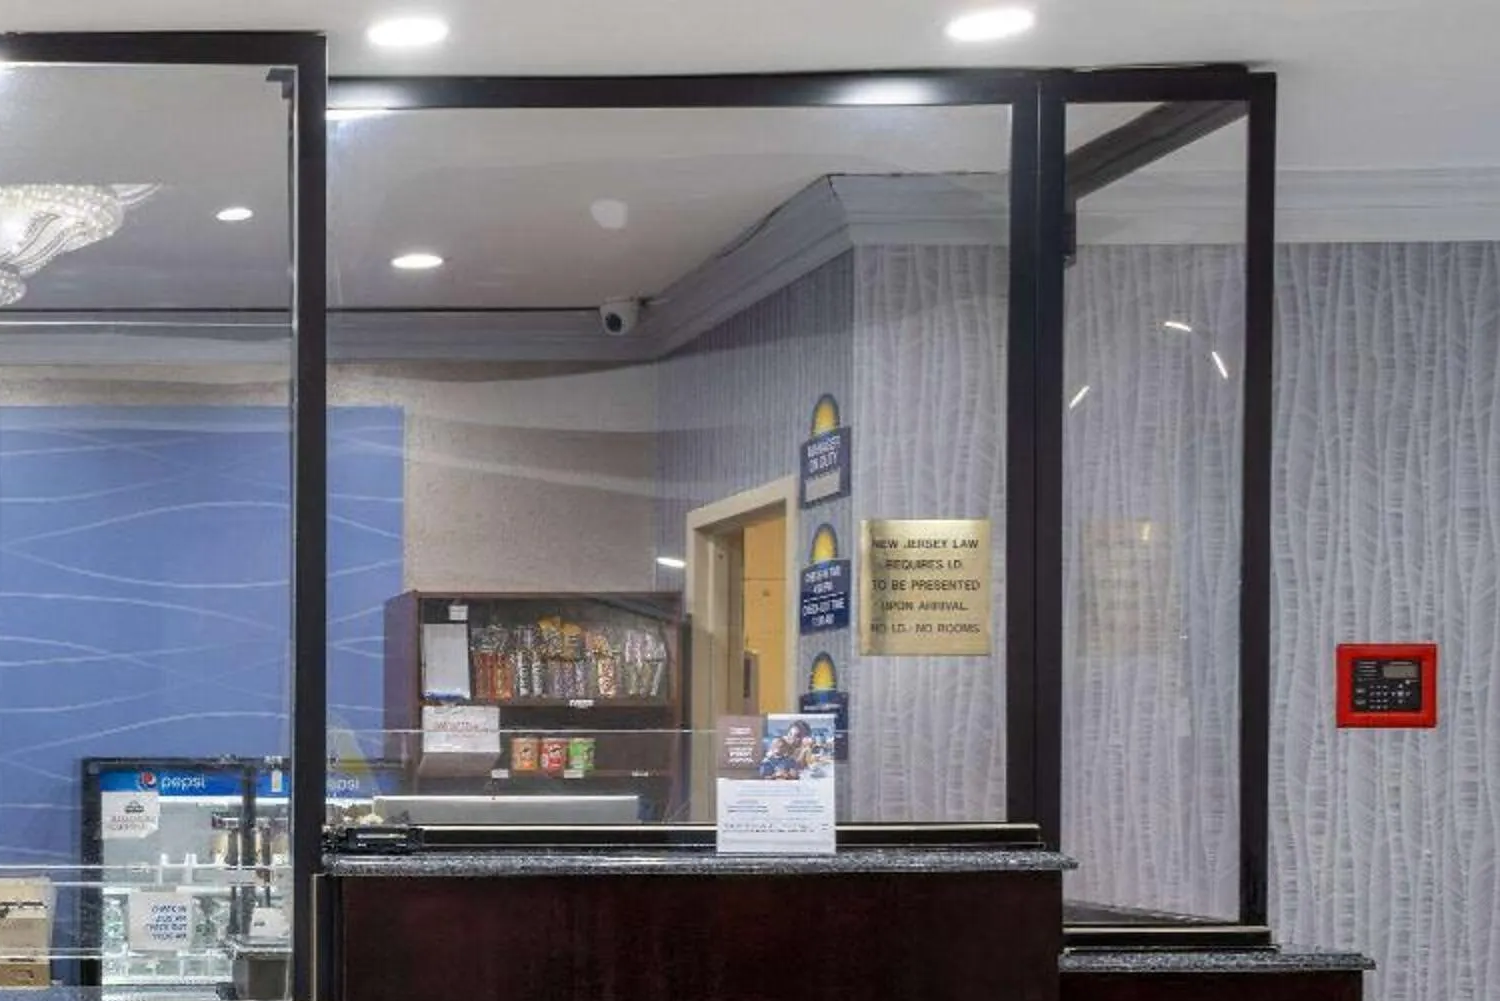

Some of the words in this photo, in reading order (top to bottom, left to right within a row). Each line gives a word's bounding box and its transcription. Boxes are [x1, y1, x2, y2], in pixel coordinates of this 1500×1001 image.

[871, 539, 899, 549] NEW
[903, 539, 949, 549] JERSEY
[952, 539, 980, 549] LAW
[885, 559, 944, 571] REQUIRES
[871, 579, 887, 591] TO
[891, 579, 907, 591] BE
[911, 579, 981, 591] PRESENTED
[881, 601, 914, 611] UPON
[870, 623, 887, 634] NO
[915, 623, 933, 634] NO
[161, 775, 206, 791] pepsi
